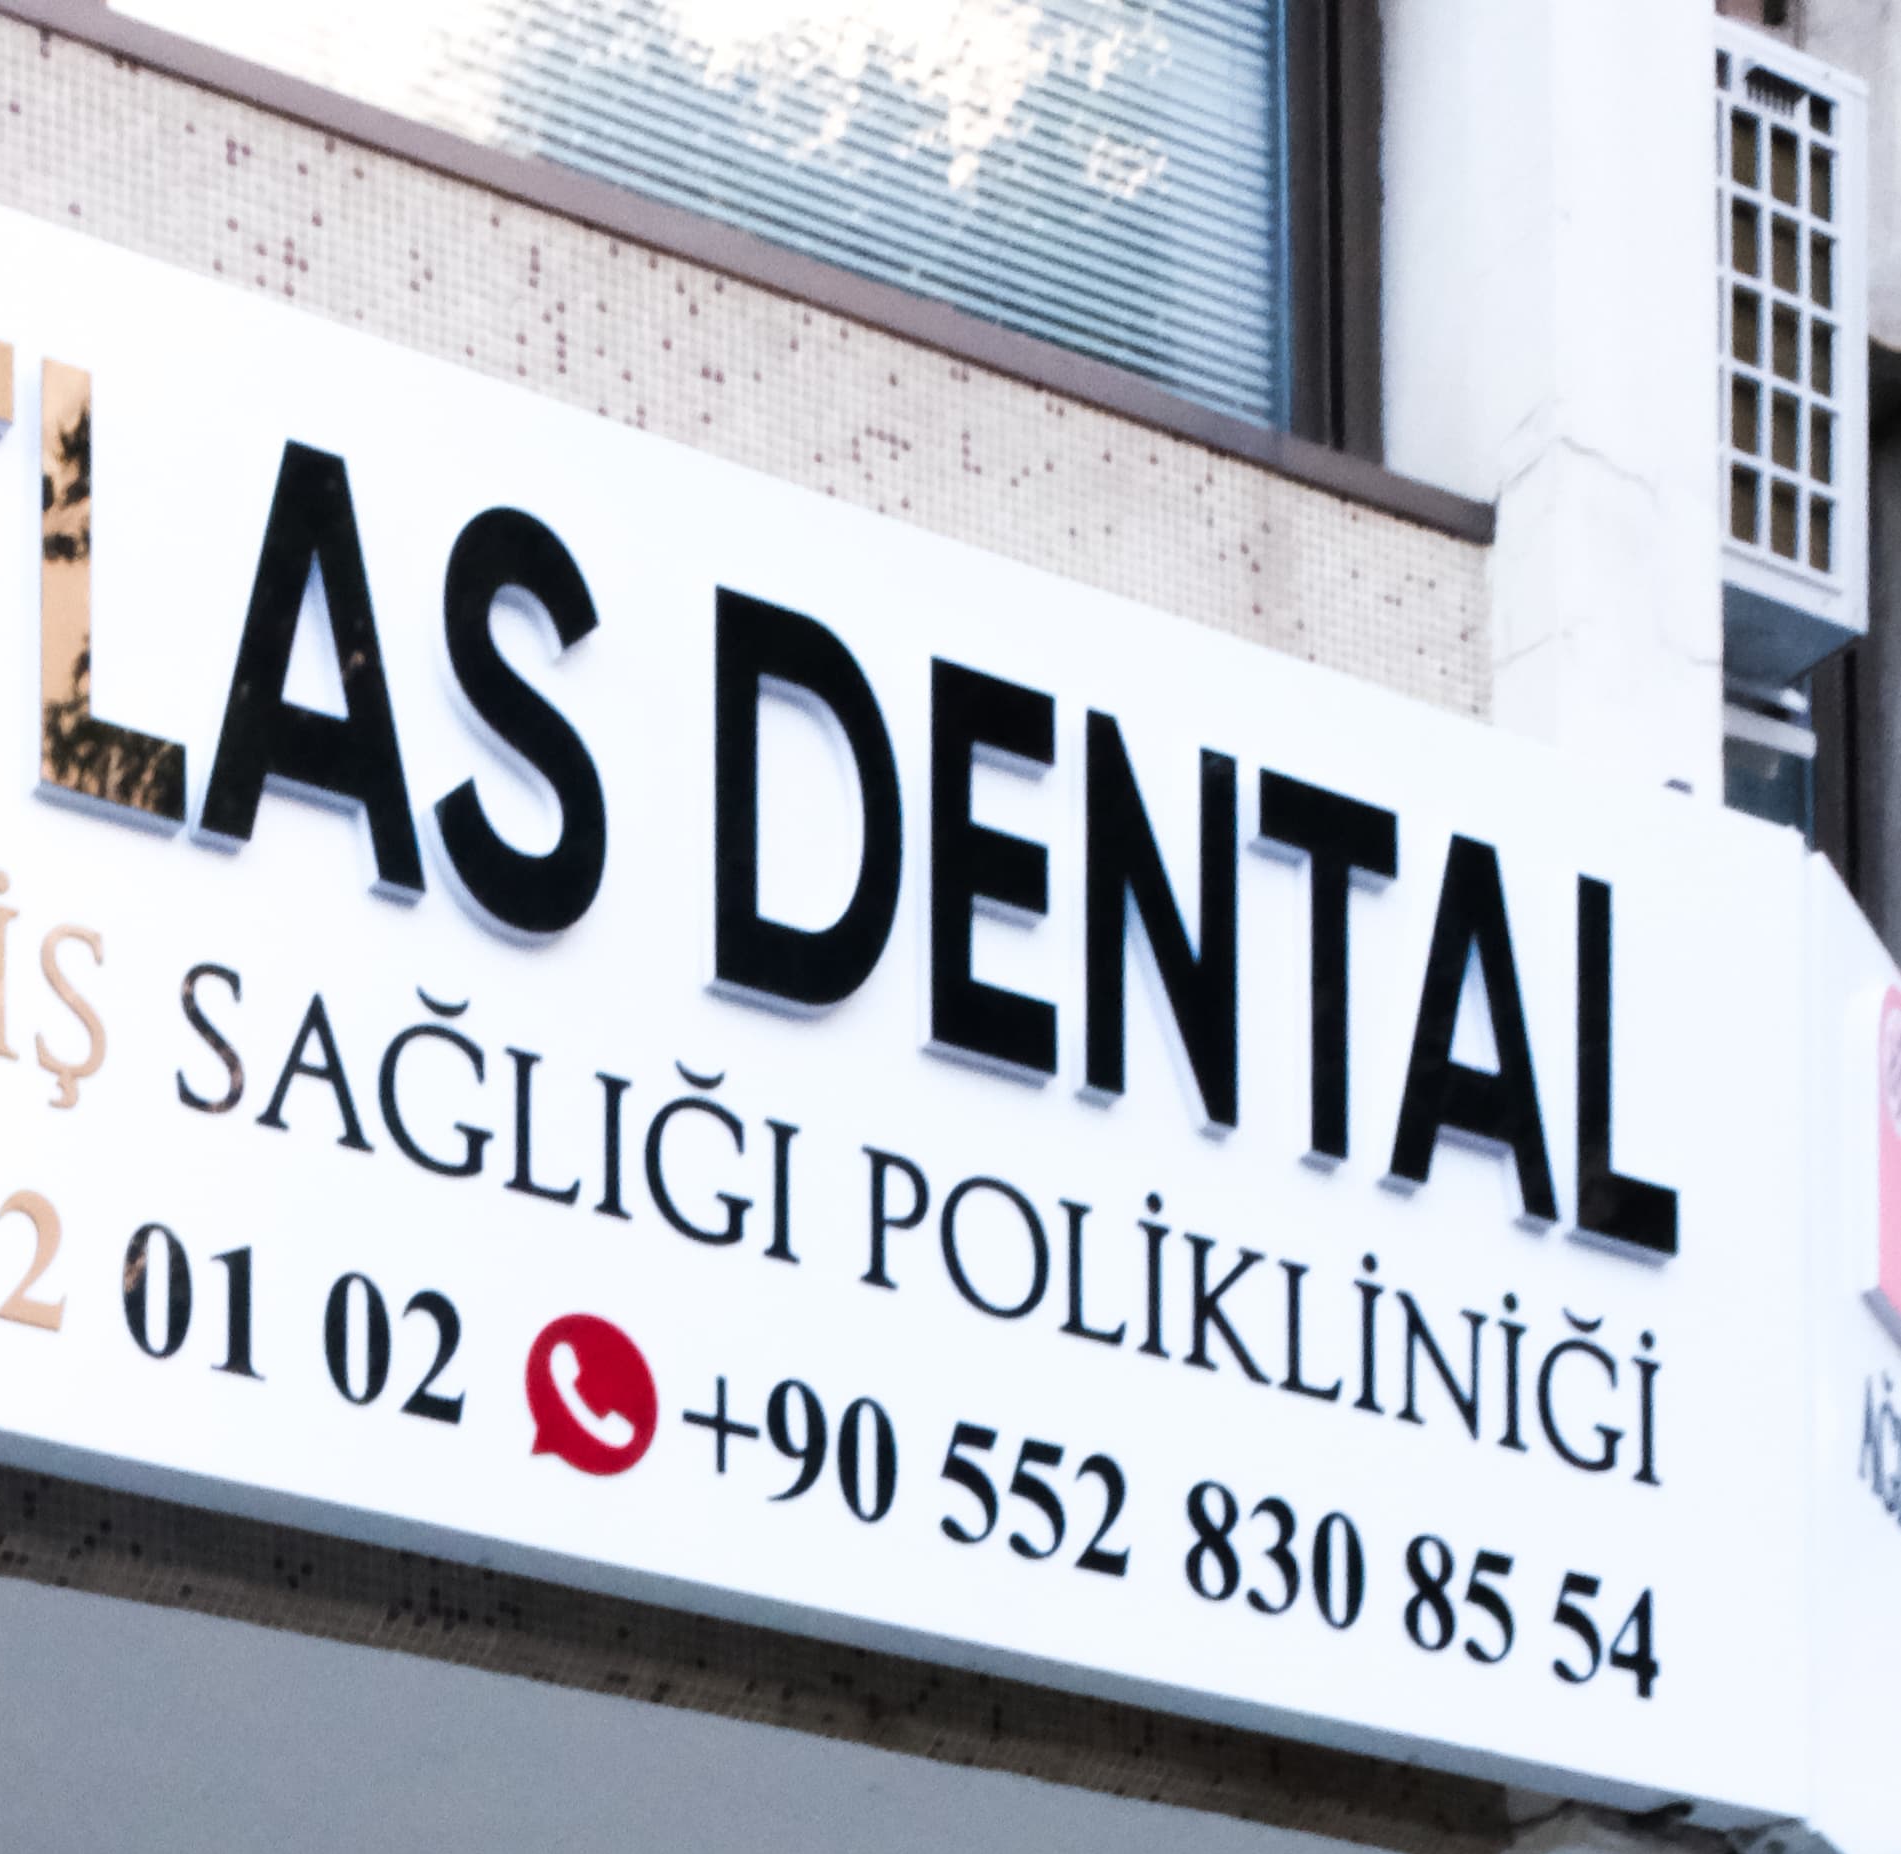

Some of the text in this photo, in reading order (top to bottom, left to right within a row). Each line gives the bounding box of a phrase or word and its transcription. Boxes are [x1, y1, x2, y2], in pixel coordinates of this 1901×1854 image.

[708, 585, 1679, 1262] DENTAL
[122, 1222, 266, 1384] 01
[322, 1272, 466, 1424] 02
[681, 1374, 899, 1524] +90
[940, 1425, 1131, 1577] 552
[1183, 1480, 1365, 1631] 830
[1401, 1535, 1514, 1669] 85
[1549, 1588, 1659, 1698] 54
[175, 962, 799, 1265] SAĞLIĞI
[860, 1145, 1665, 1487] POLİKLİNİĞİ
